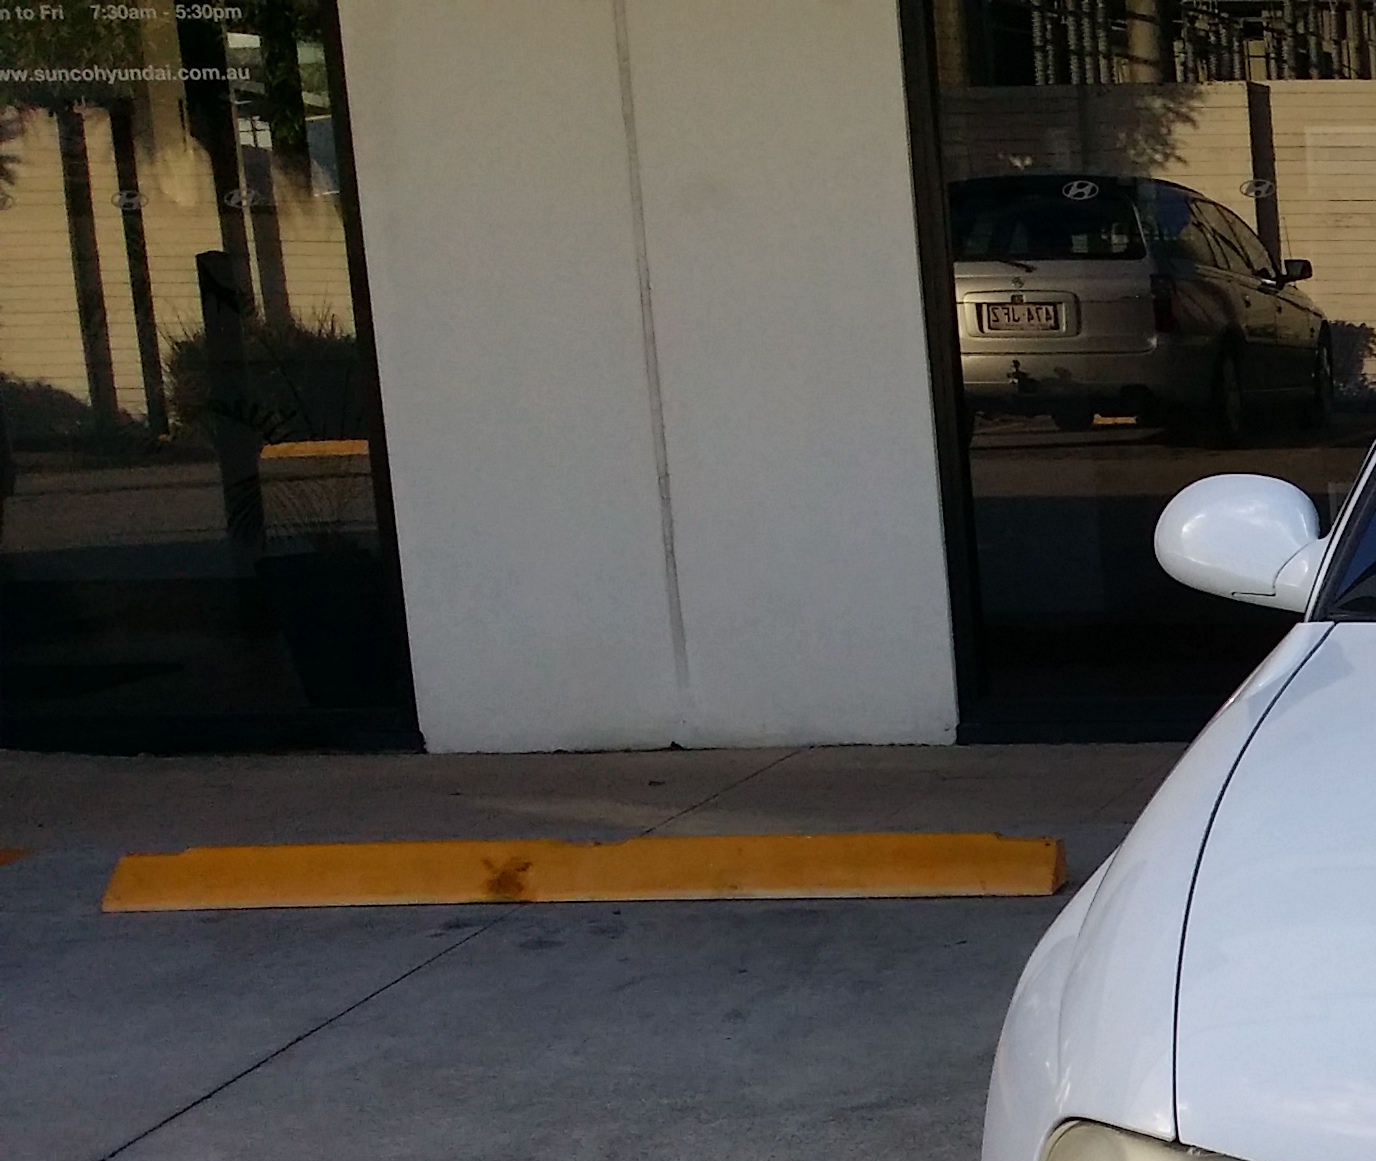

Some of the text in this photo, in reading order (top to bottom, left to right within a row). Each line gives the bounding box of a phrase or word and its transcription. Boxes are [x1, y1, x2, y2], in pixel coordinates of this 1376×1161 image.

[15, 6, 35, 20] to
[40, 5, 64, 20] Fri
[90, 4, 157, 20] 7:30am
[176, 4, 243, 22] 5:30pm
